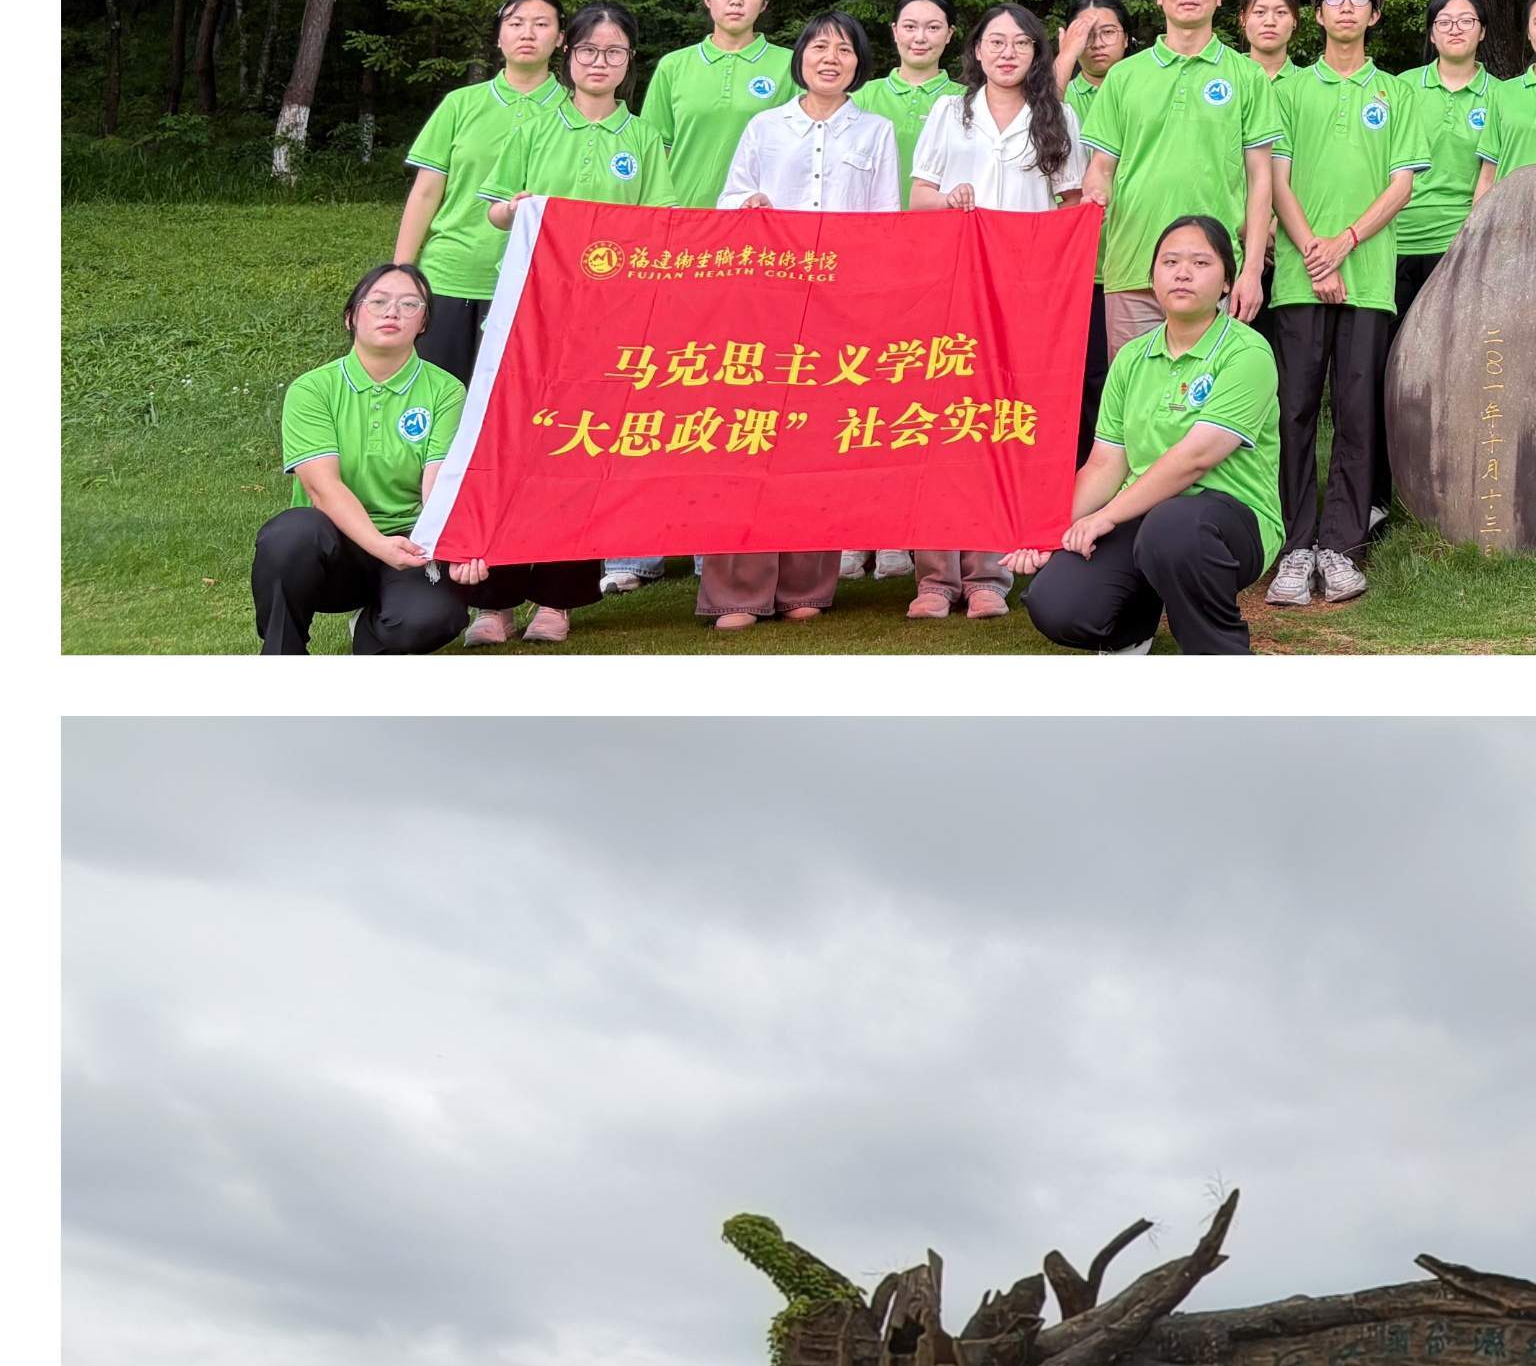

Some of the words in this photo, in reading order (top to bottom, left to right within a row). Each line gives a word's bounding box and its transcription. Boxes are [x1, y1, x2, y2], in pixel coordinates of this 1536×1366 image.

[627, 270, 684, 281] FUJIAN
[694, 267, 755, 279] HEALTH
[764, 269, 837, 283] COLLEGE
[605, 332, 978, 391] 马克思主义学院
